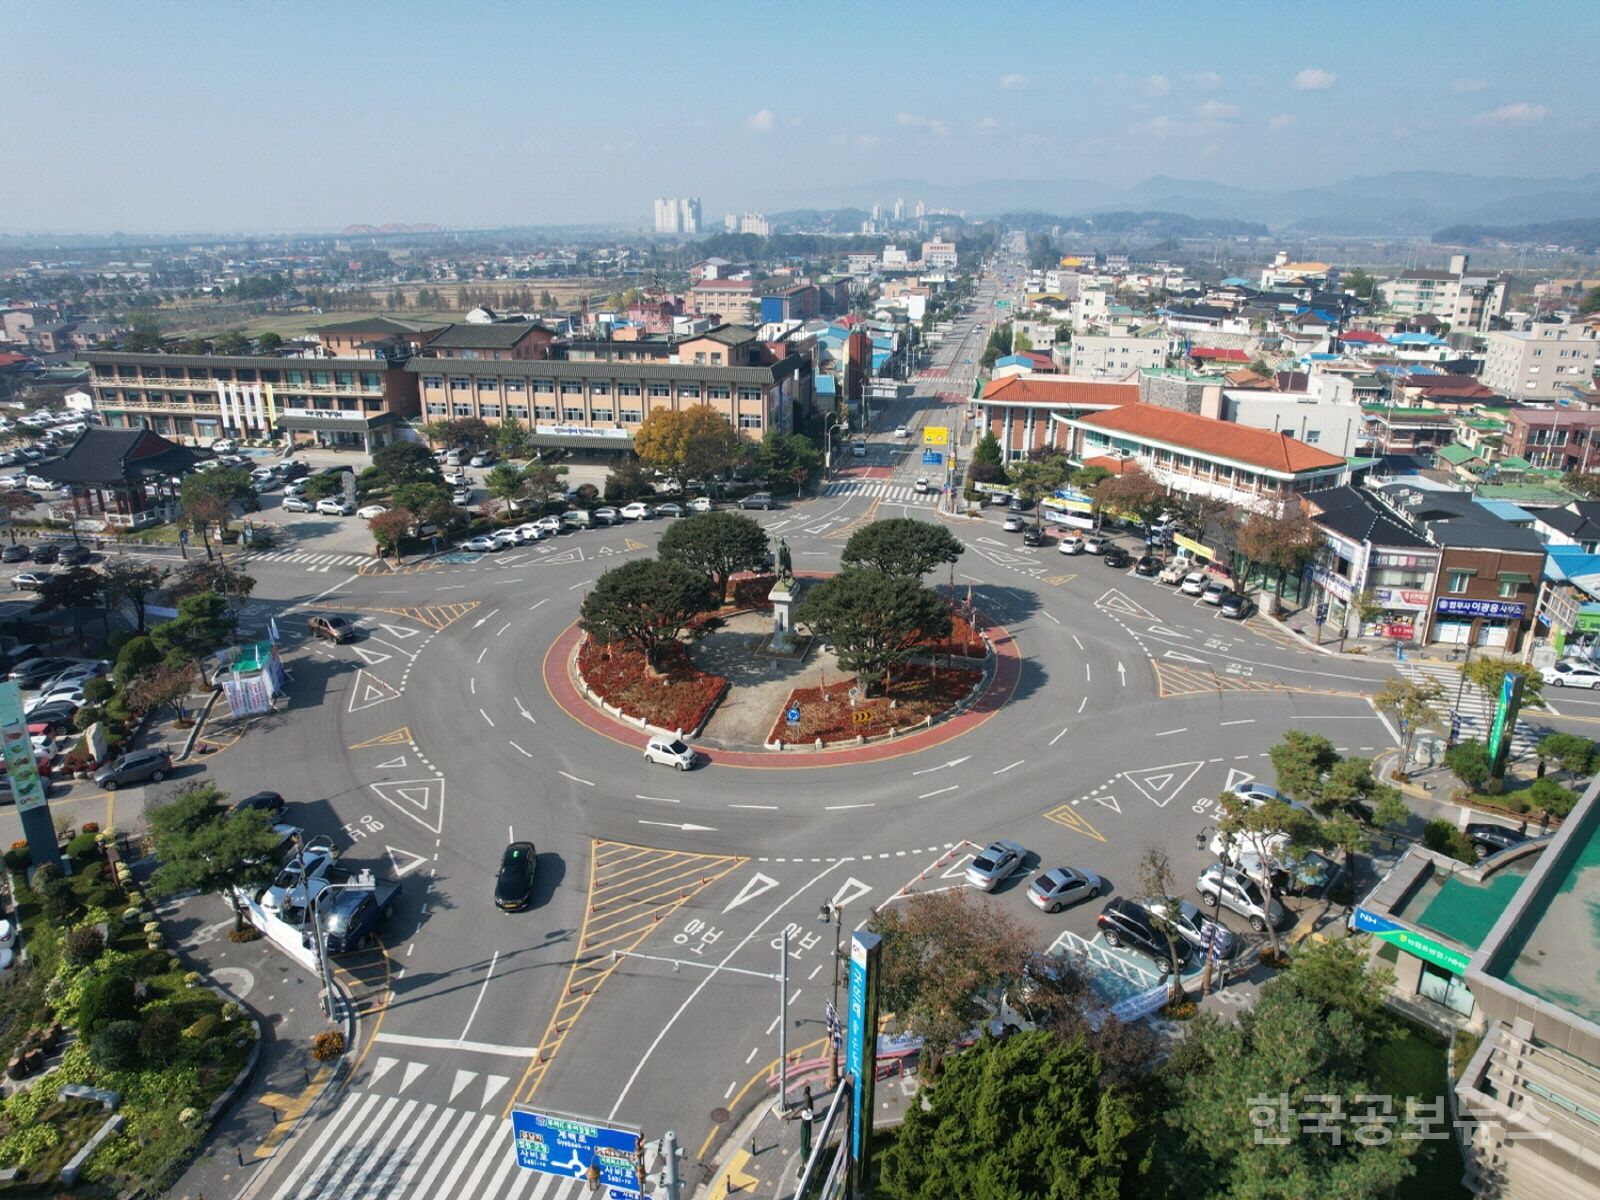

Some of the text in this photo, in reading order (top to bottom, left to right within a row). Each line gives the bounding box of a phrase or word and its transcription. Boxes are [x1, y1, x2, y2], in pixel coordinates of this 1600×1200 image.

[1360, 912, 1377, 925] NH
[673, 919, 724, 954] 양보
[771, 922, 822, 959] 양보
[558, 1130, 587, 1143] 계백로
[520, 1149, 548, 1161] 사비로
[605, 1165, 634, 1178] 사비로
[607, 1174, 632, 1185] Sabi-ro
